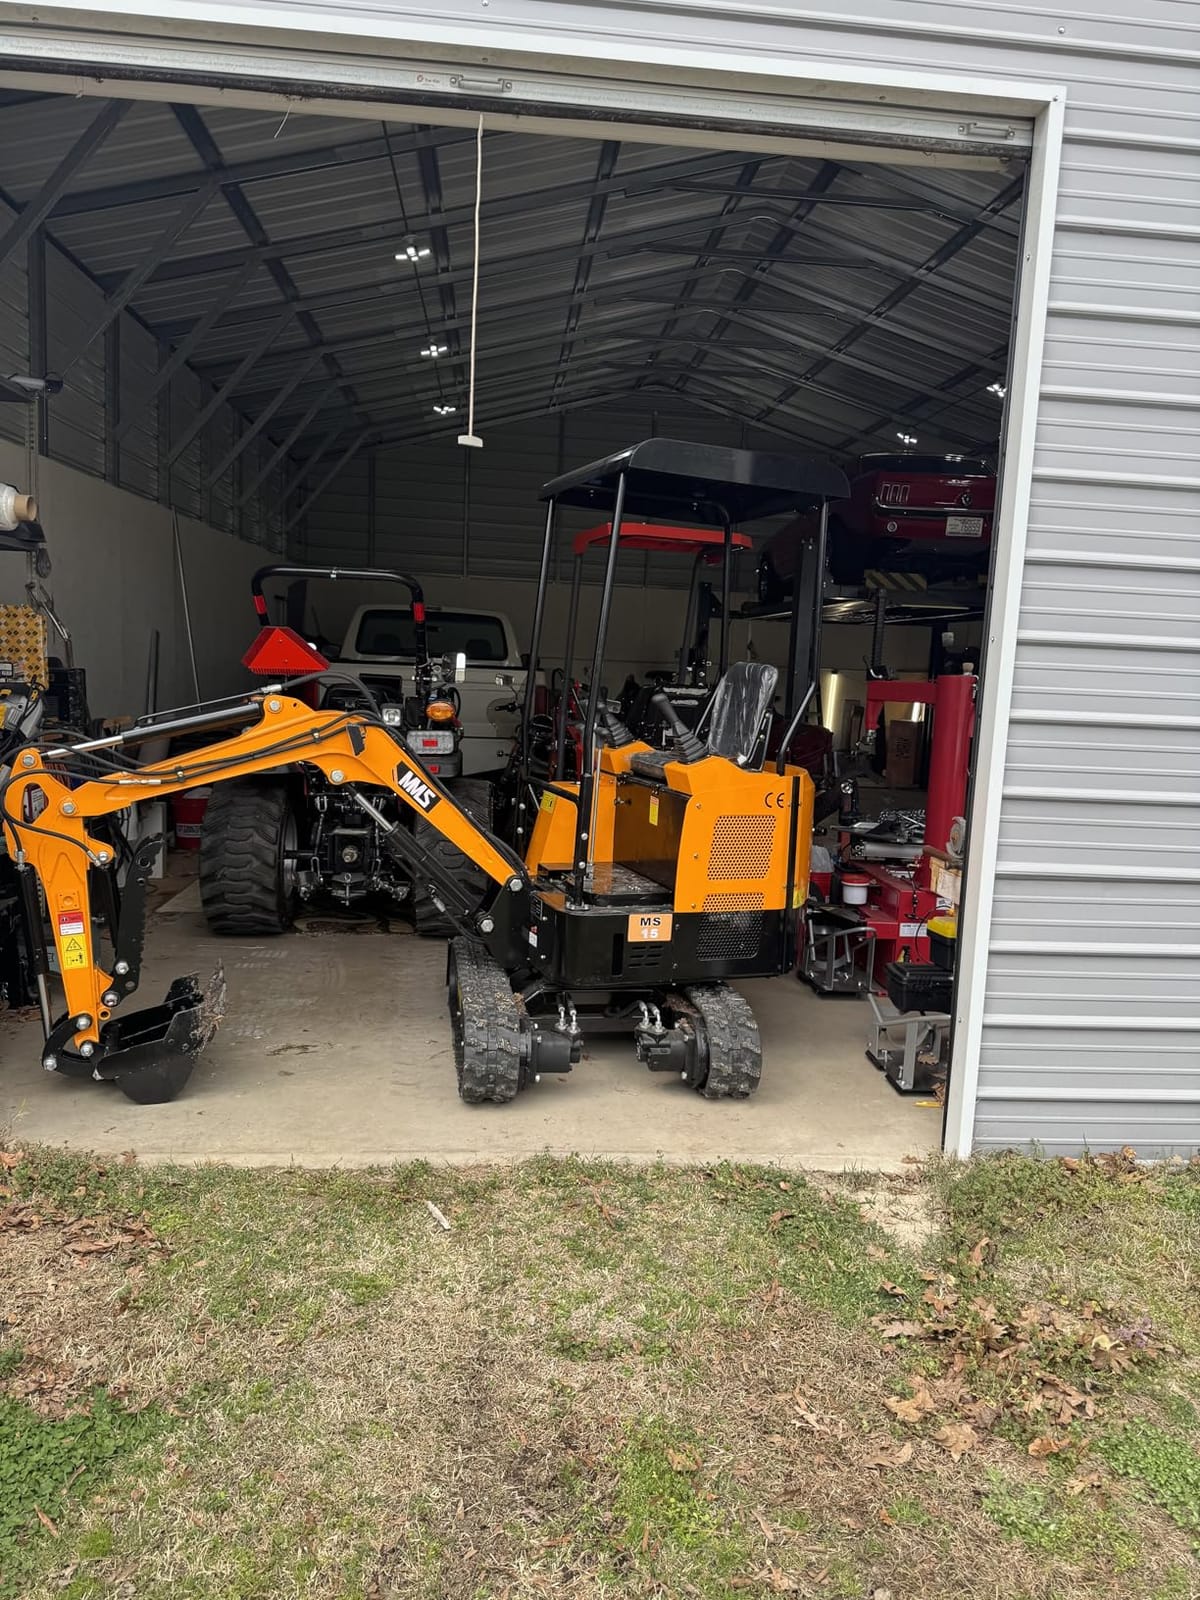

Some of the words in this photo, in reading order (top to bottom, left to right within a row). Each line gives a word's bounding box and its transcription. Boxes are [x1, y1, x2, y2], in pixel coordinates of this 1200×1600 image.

[398, 770, 437, 809] MMS
[764, 792, 785, 808] CE
[640, 917, 661, 927] MS
[641, 928, 658, 939] 15
